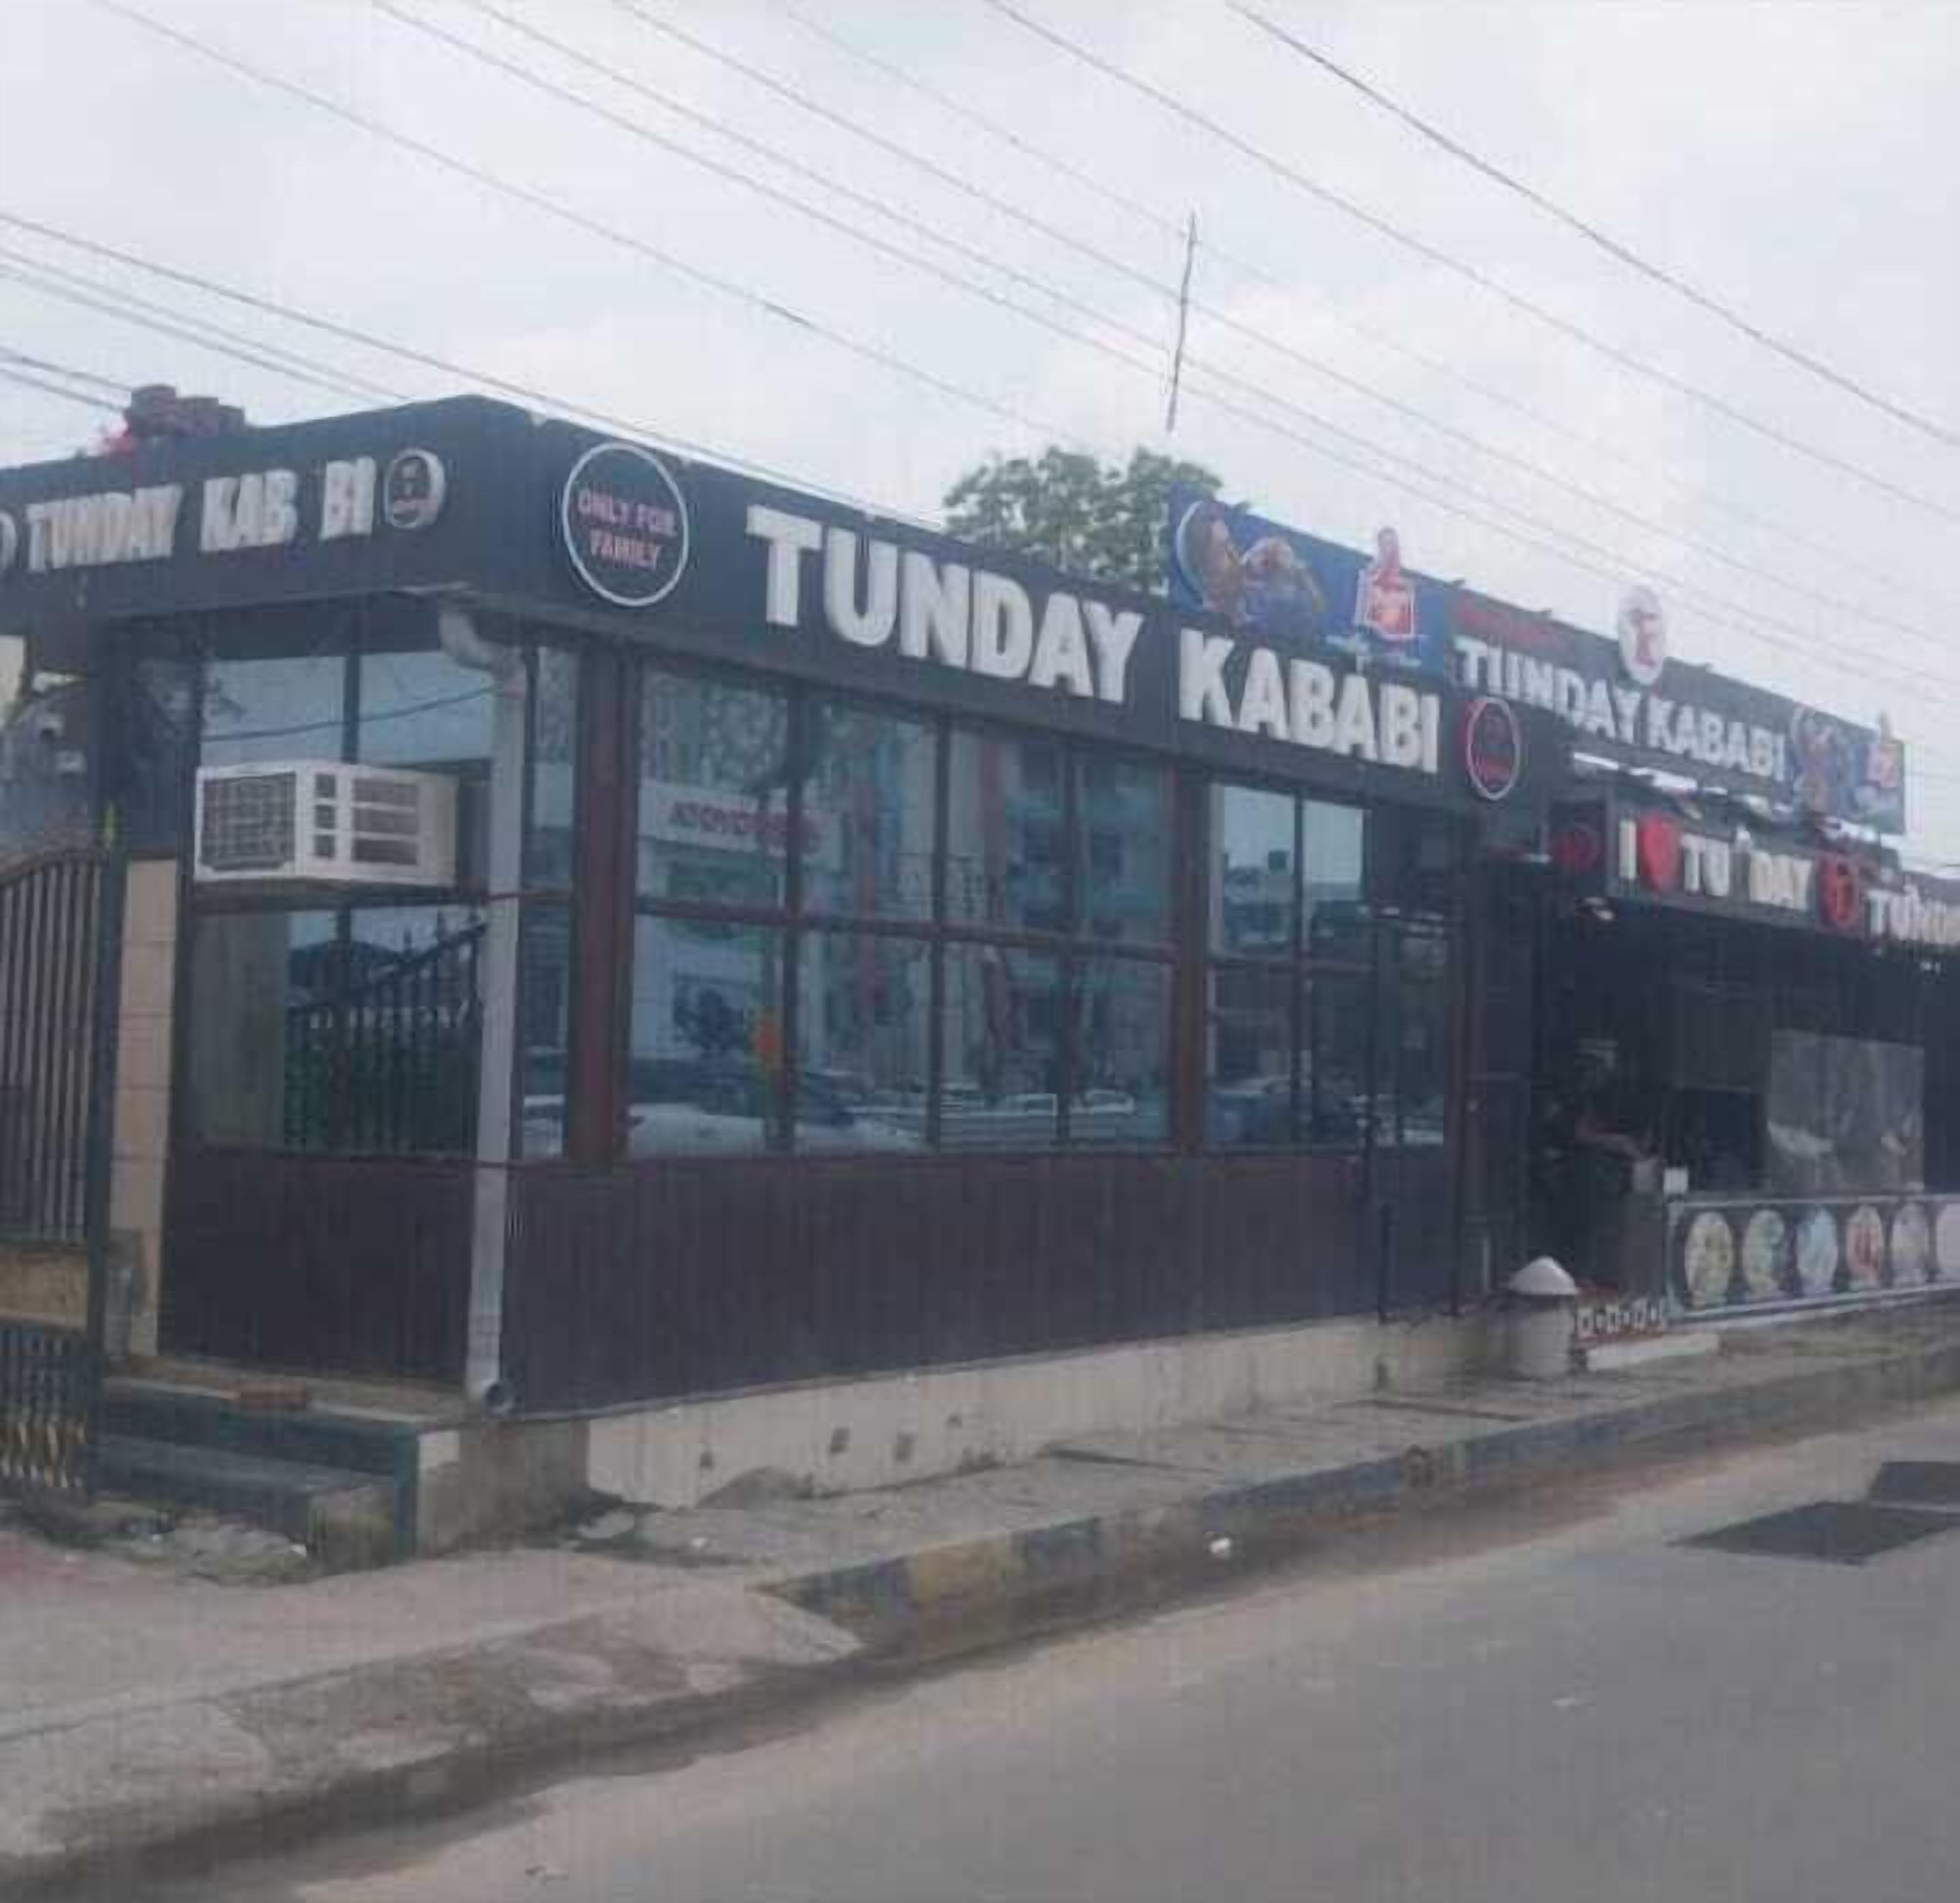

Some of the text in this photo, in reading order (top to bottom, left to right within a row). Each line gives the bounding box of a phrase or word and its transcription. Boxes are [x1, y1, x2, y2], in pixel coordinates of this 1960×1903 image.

[577, 487, 678, 537] ONLY FOR
[590, 528, 663, 571] FAMILY
[745, 504, 1144, 704] TUNDAY
[1178, 627, 1441, 773] KABABI
[1647, 695, 1786, 782] KABABI
